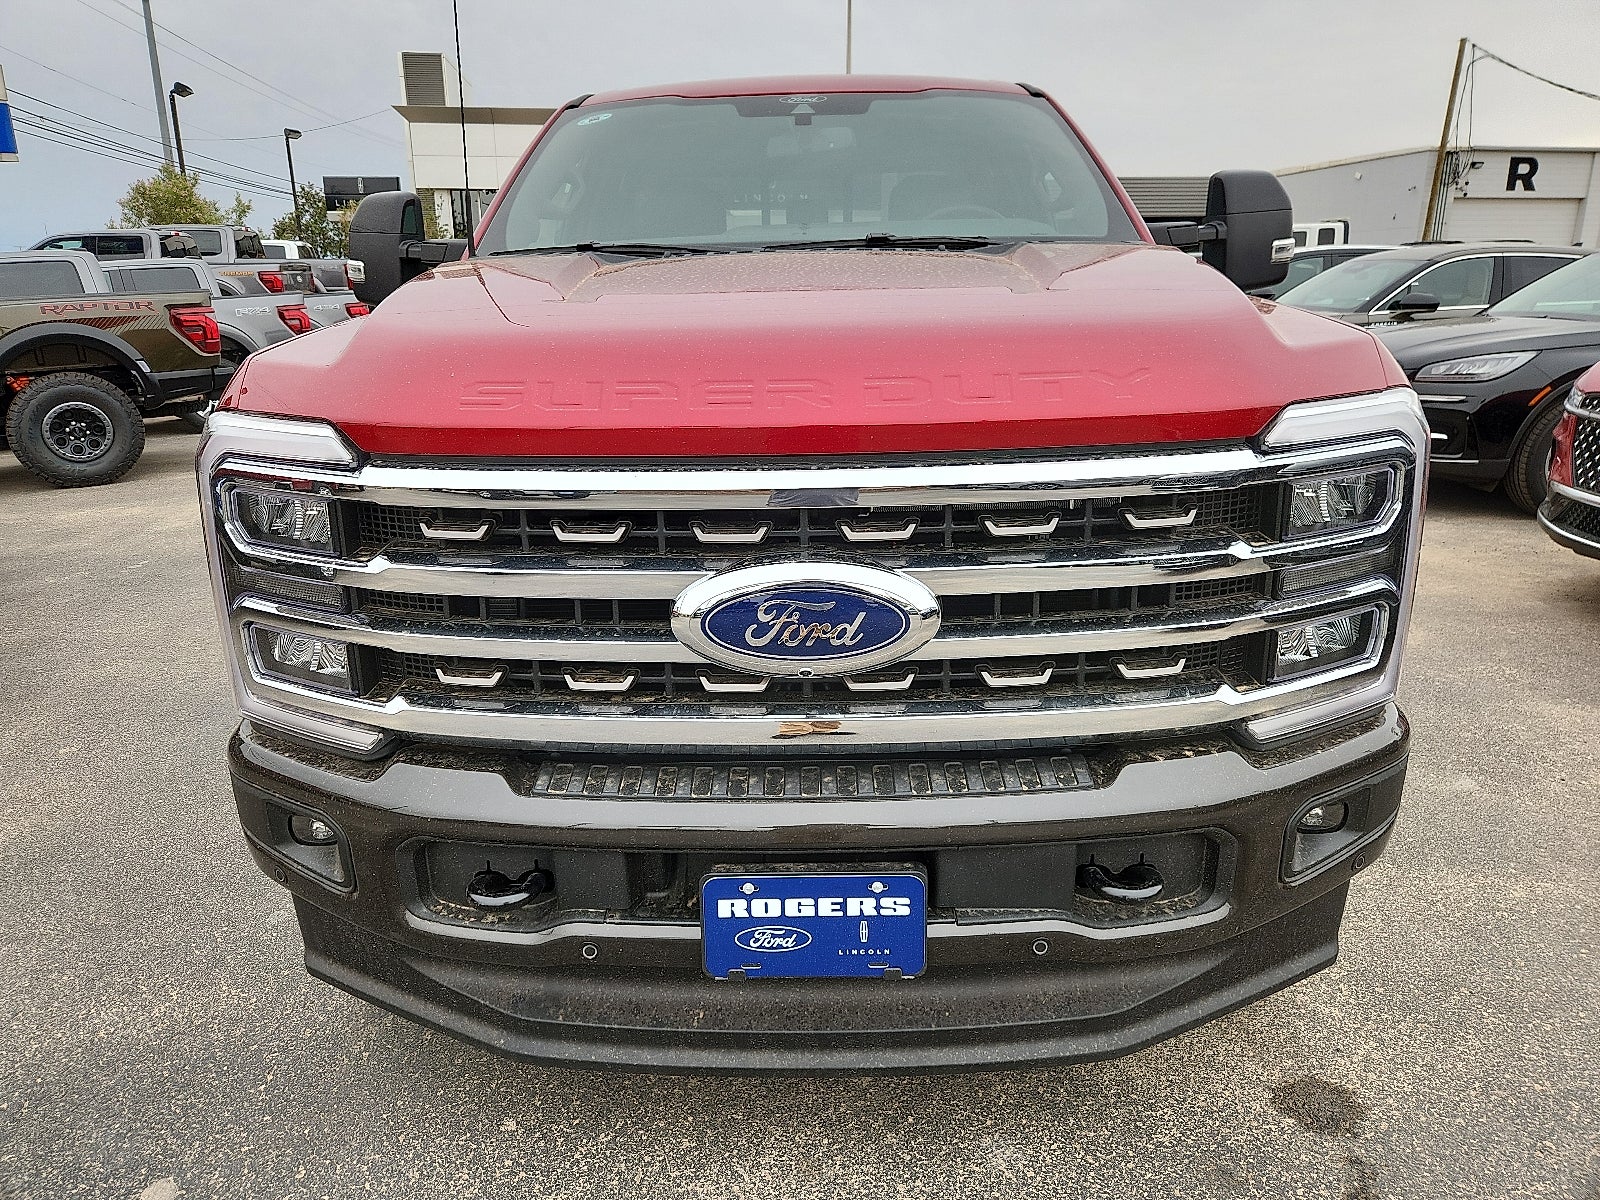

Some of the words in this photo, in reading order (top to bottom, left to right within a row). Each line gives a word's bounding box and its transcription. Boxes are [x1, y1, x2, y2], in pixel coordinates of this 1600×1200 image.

[1505, 157, 1539, 192] R
[40, 300, 160, 317] RAPTOR
[459, 378, 834, 412] SUPER
[863, 368, 1151, 407] DUTY
[745, 599, 867, 648] Ford
[717, 897, 911, 919] ROGERS
[749, 928, 797, 949] Ford
[838, 948, 891, 956] LINCOLN
